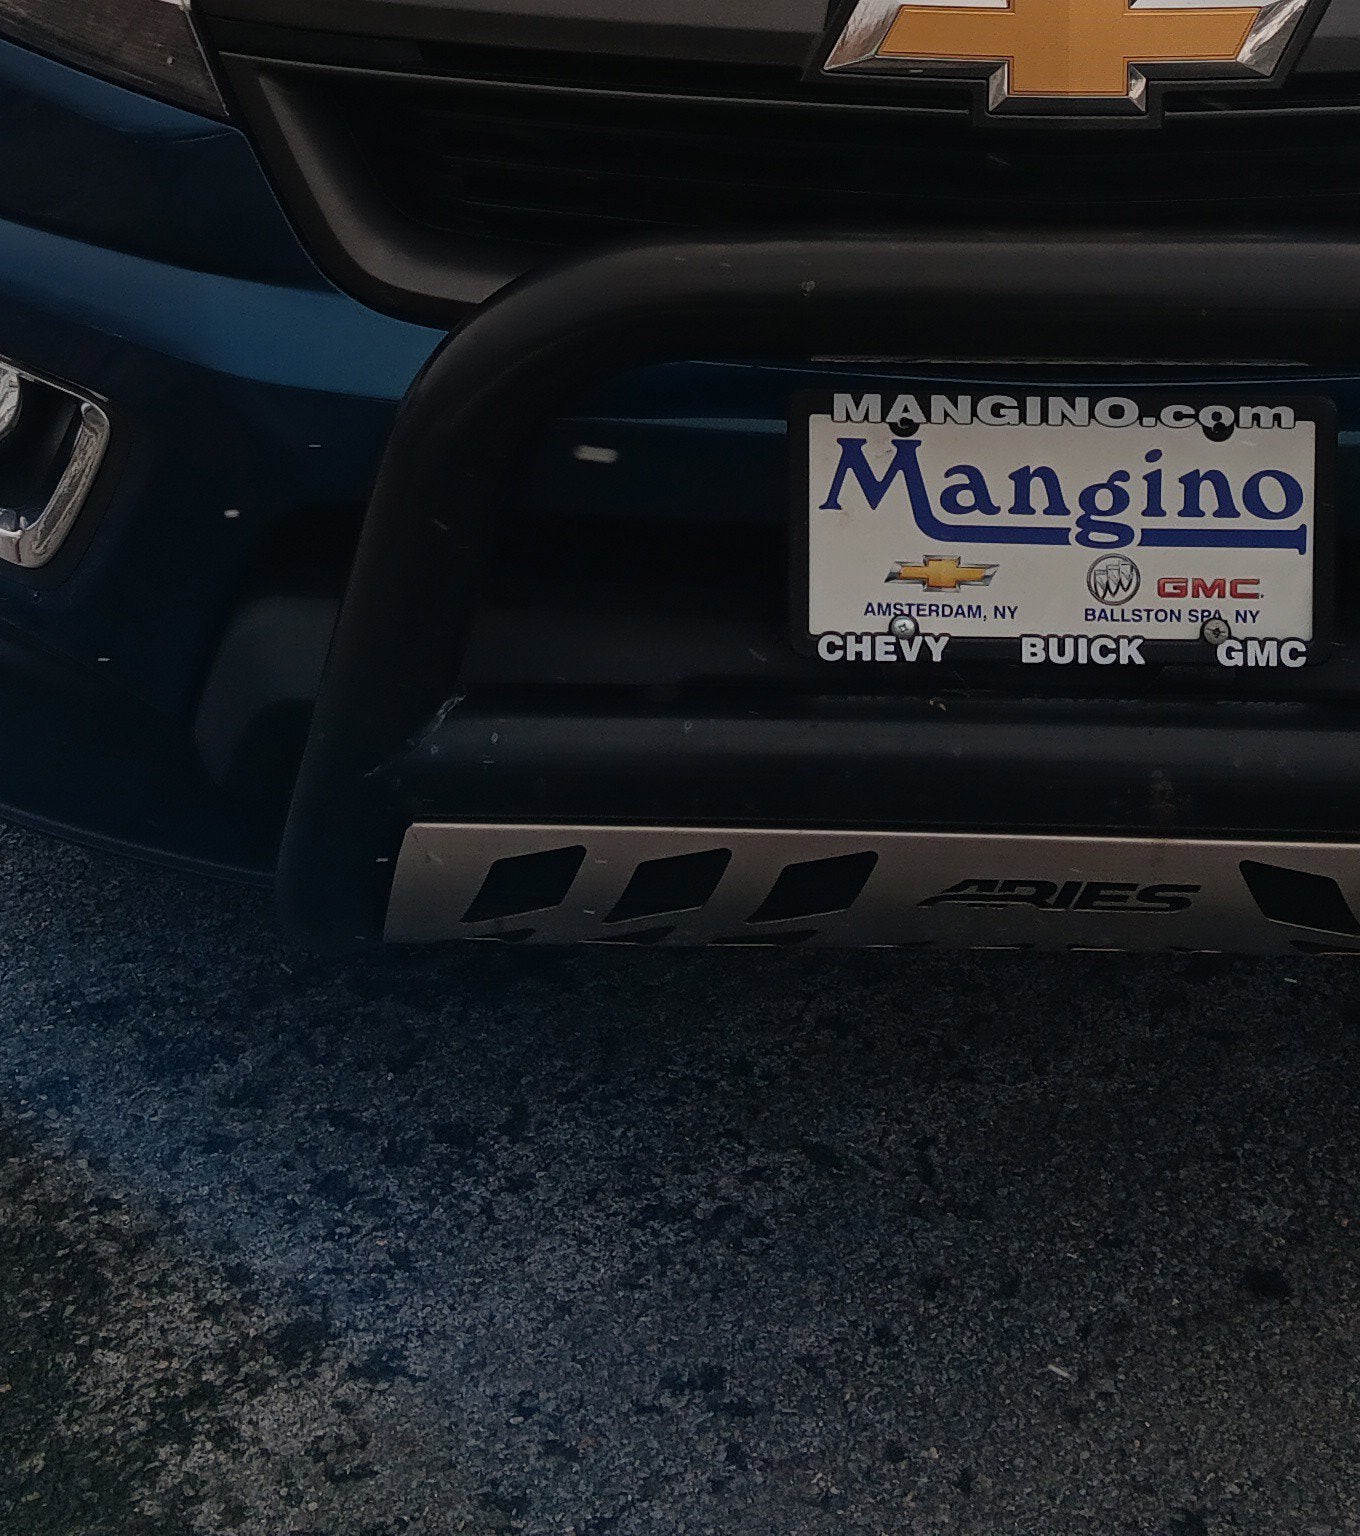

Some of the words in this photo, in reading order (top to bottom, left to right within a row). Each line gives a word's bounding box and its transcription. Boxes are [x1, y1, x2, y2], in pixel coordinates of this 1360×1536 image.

[833, 393, 1296, 429] MANGINO.com
[818, 436, 1307, 556] Mangino
[1157, 577, 1261, 600] GMC
[864, 602, 987, 622] AMSTERDAM,
[993, 605, 1019, 620] NY
[1084, 607, 1182, 624] BALLSTON
[1235, 610, 1261, 624] NY
[817, 634, 950, 663] CHEVY
[1020, 636, 1146, 666] BUICK
[1216, 639, 1308, 669] GMC
[916, 878, 1202, 914] ARIES
